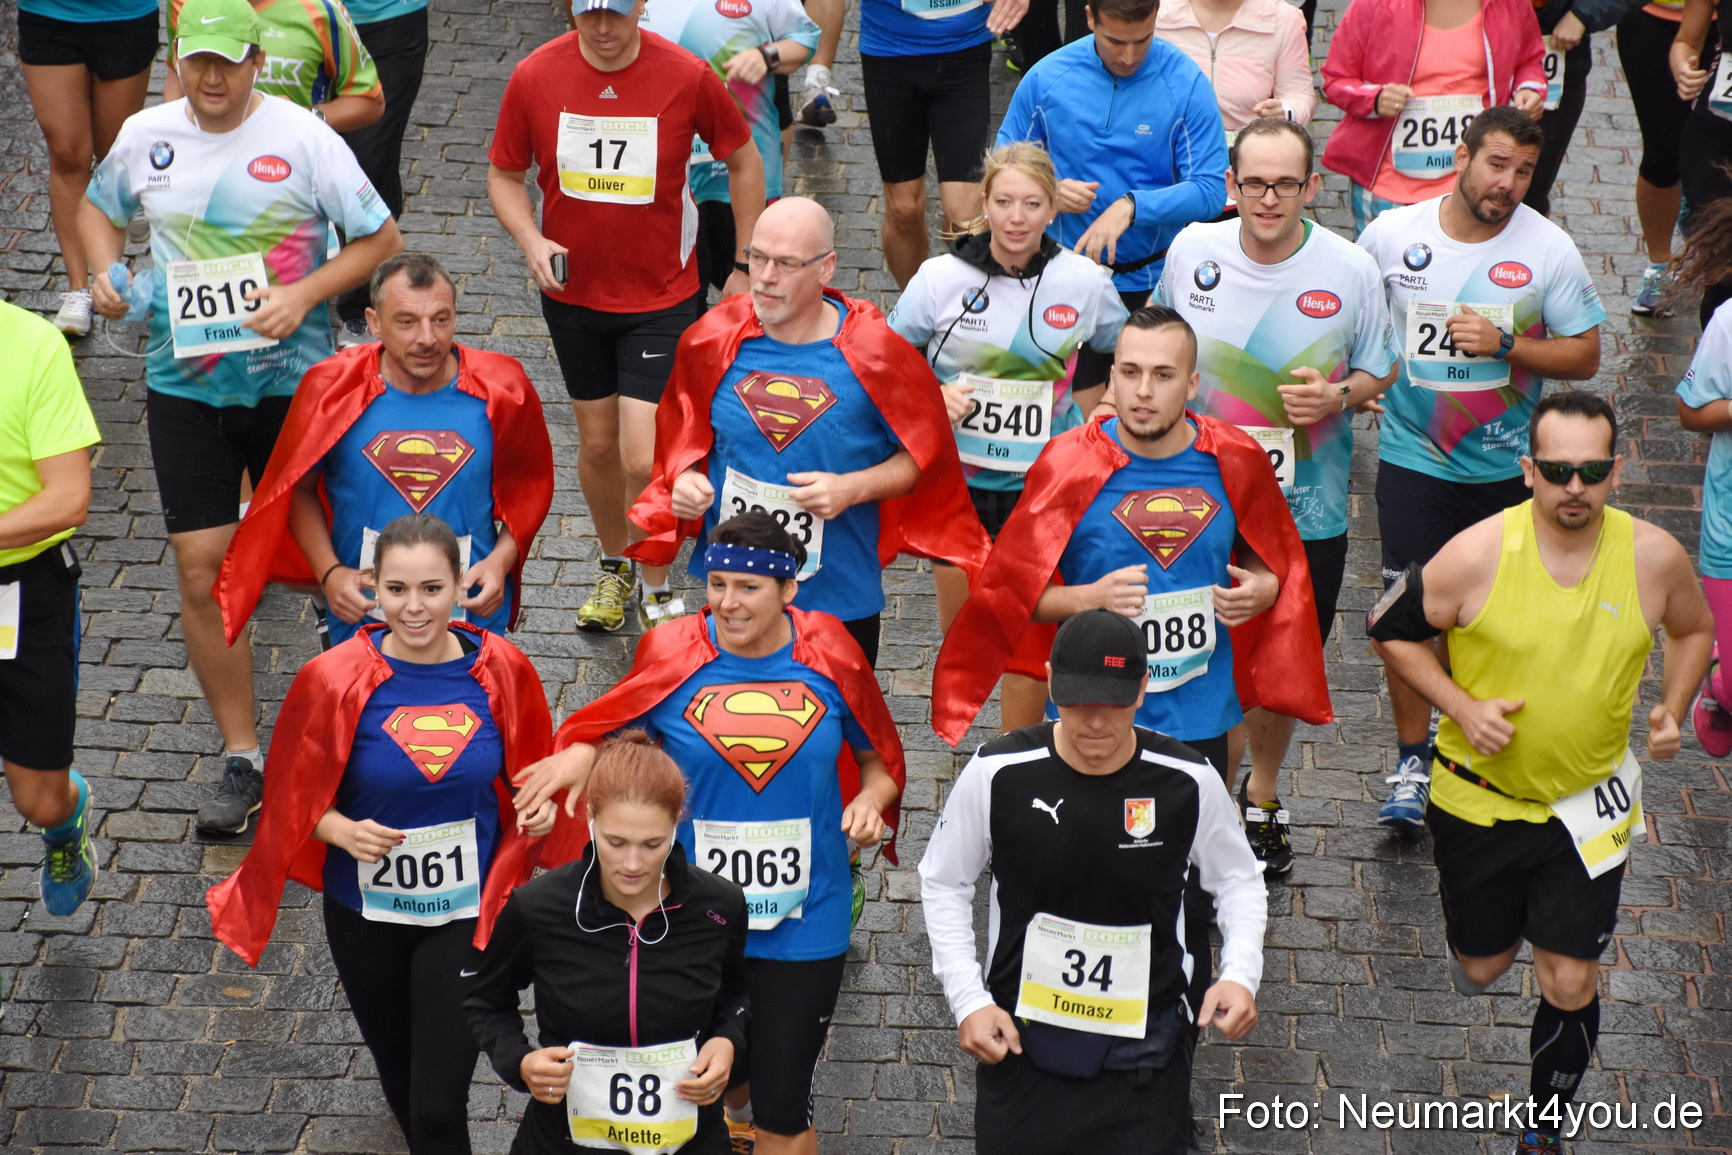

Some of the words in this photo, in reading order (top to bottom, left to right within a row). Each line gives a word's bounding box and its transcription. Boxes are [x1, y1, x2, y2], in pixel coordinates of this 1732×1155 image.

[719, 1, 749, 13] Hervis
[260, 57, 304, 86] CK
[566, 124, 597, 133] NeuerMarkt
[601, 120, 648, 132] BOCK
[1402, 114, 1475, 148] 2648
[588, 138, 628, 170] 17
[1425, 155, 1453, 168] Anja
[253, 160, 288, 177] Hervis
[588, 177, 626, 191] Oliver
[1400, 273, 1428, 286] PARTL
[1494, 266, 1528, 282] Hervis
[1399, 282, 1428, 292] Neumarkt
[177, 278, 261, 320] 2619
[1189, 292, 1216, 307] PARTL
[1302, 295, 1337, 312] Hervis
[1048, 309, 1076, 323] Hervis
[1188, 302, 1215, 314] Neumarkt
[1415, 309, 1448, 318] NeuerMarkt
[204, 324, 242, 341] Frank
[1417, 322, 1503, 359] 24
[1447, 365, 1470, 380] Roi
[999, 383, 1044, 396] BOCK
[961, 397, 1043, 437] 2540
[1249, 430, 1287, 441] OCK
[1483, 420, 1505, 436] 17.
[987, 443, 1010, 458] Eva
[731, 480, 759, 497] NeuerMarkt
[1153, 591, 1205, 610] BOCK
[1141, 612, 1208, 655] 088
[1148, 664, 1179, 679] Max
[1593, 775, 1631, 821] 40
[408, 823, 465, 846] BOCK
[703, 832, 739, 841] NeuerMarkt
[745, 823, 801, 841] BOCK
[371, 844, 465, 890] 2061
[707, 846, 802, 889] 2063
[392, 897, 451, 914] Antonia
[747, 899, 778, 915] sela
[1037, 924, 1076, 941] NeuerMarkt
[1083, 927, 1141, 945] BOCK
[1061, 948, 1113, 993] 34
[1052, 993, 1114, 1020] Tomasz
[576, 1055, 619, 1065] NeuerMarkt
[625, 1045, 687, 1064] BOCK
[609, 1072, 662, 1117] 68
[607, 1125, 662, 1146] Arlette
